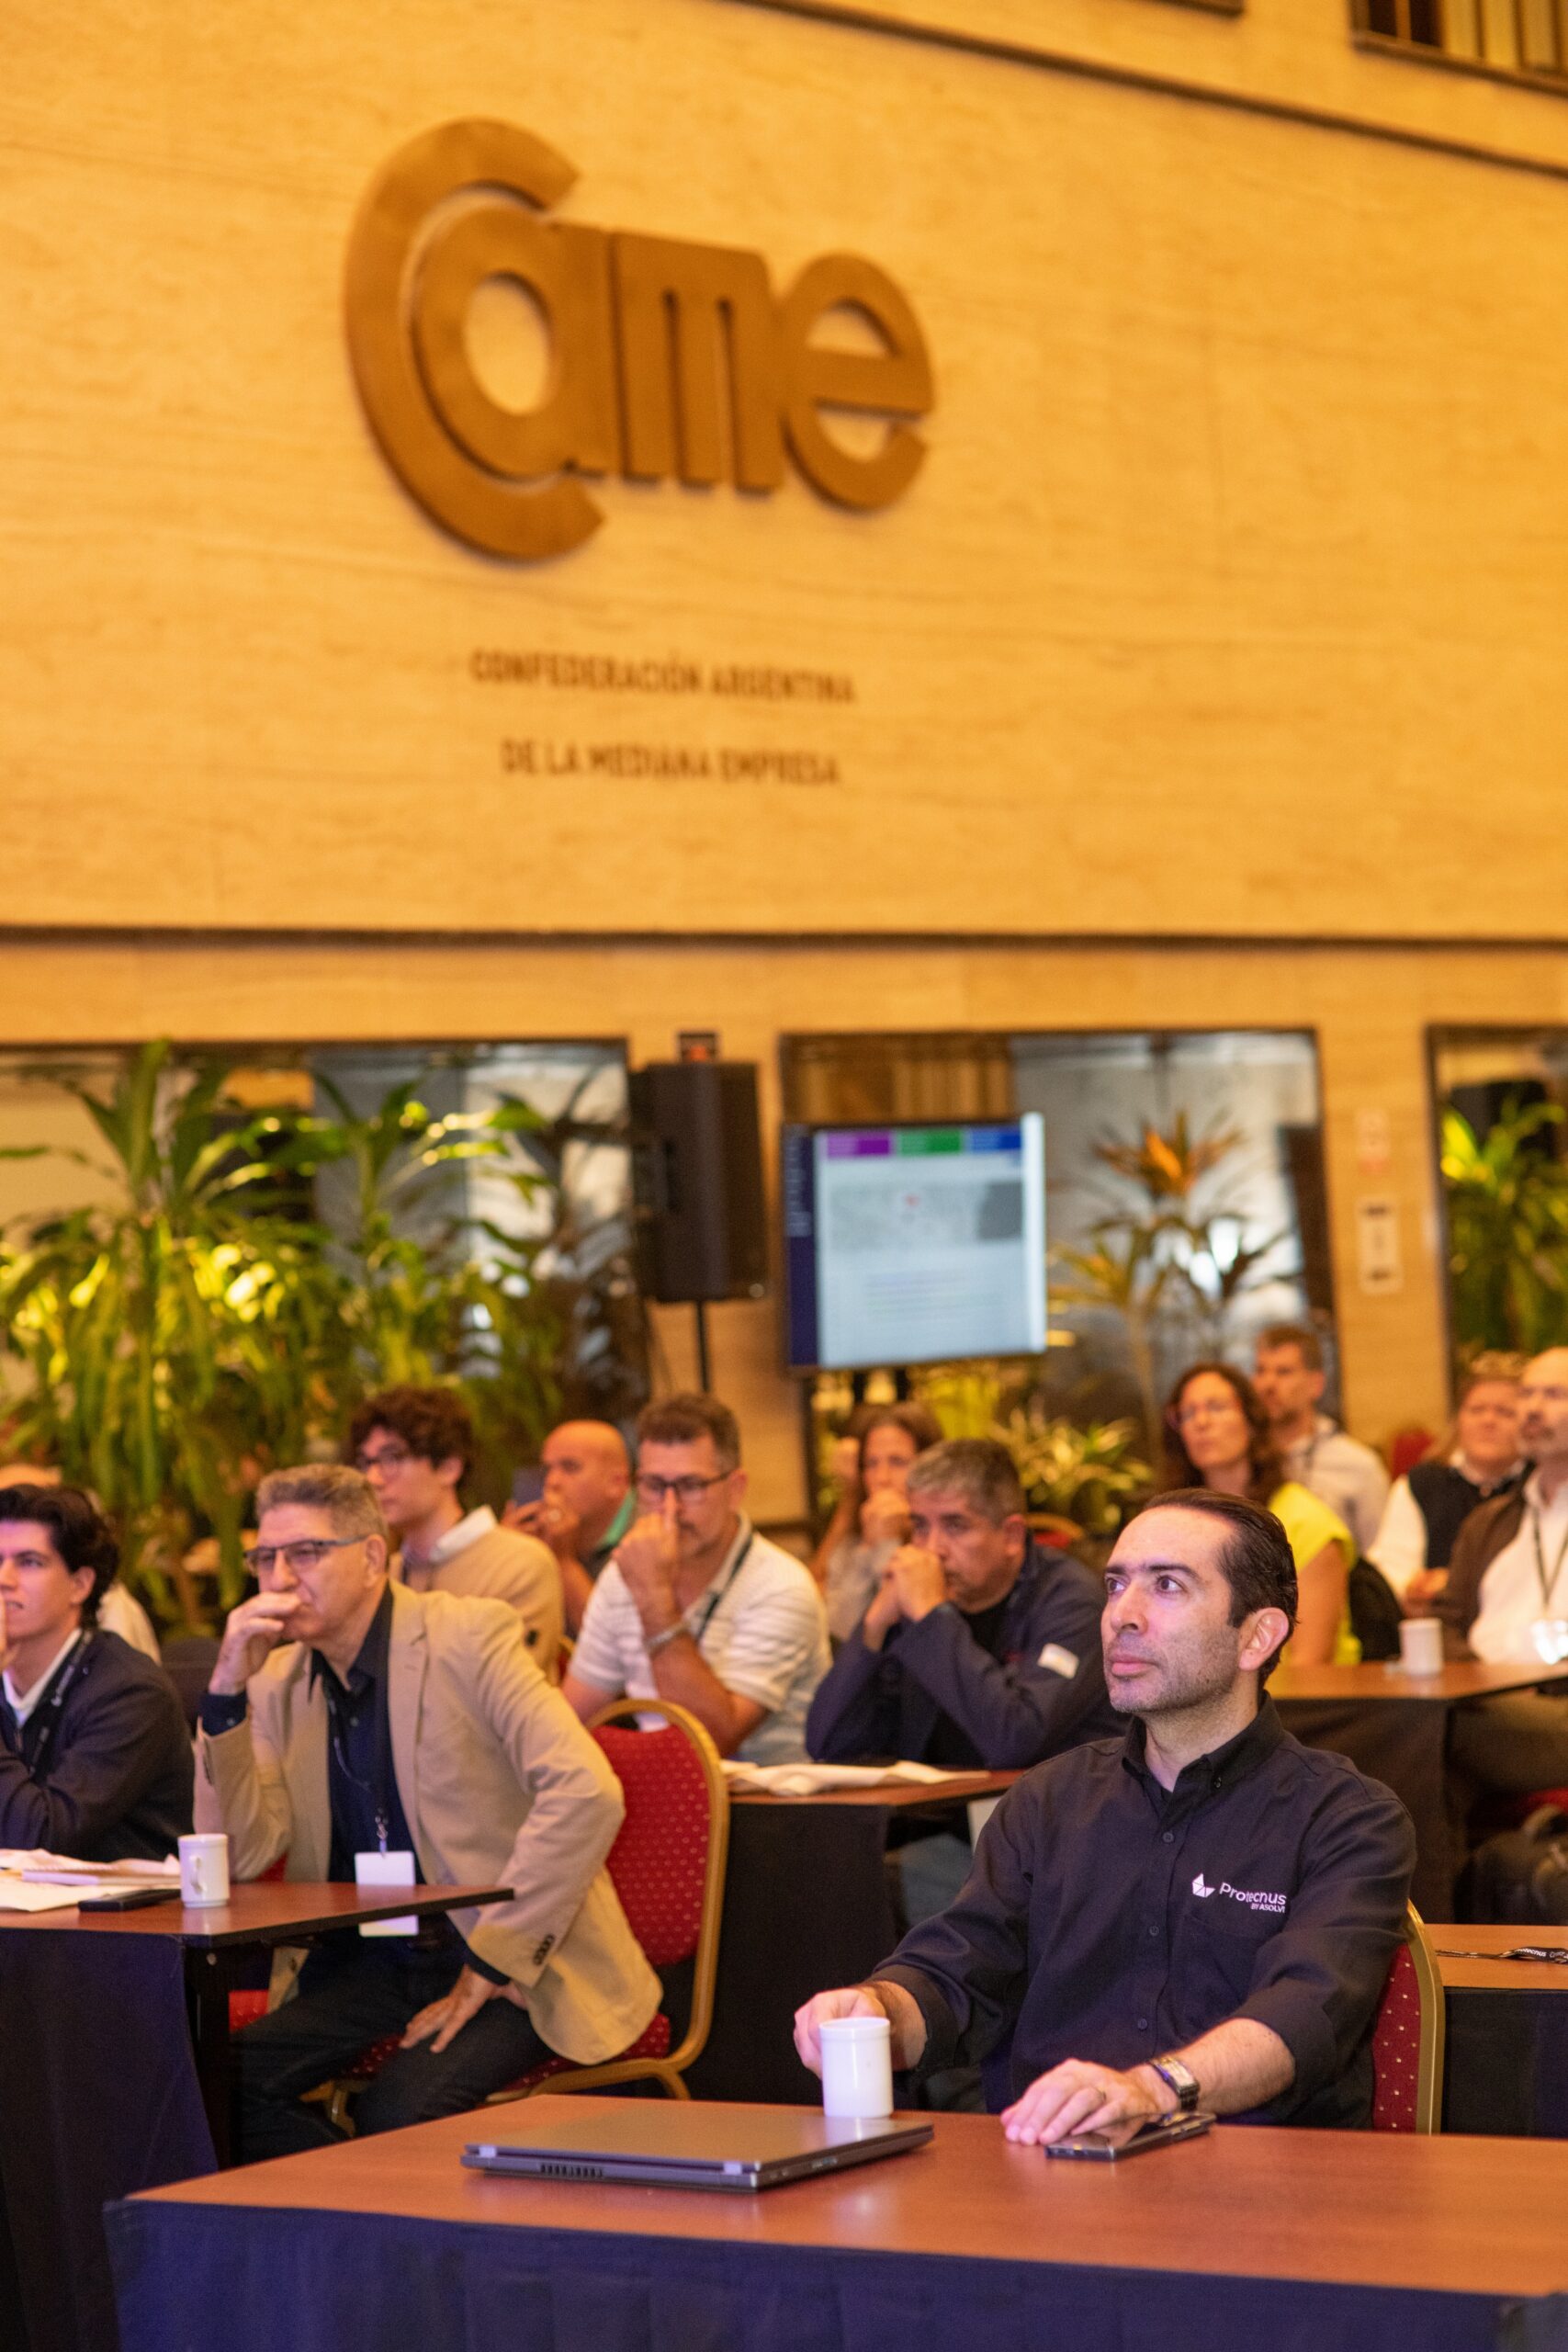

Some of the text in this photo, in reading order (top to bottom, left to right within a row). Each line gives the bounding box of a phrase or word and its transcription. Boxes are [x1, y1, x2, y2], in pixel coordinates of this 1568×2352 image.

[710, 663, 856, 703] ARGENTINA
[500, 738, 840, 786] DE LA MEDIANA EMPRESA
[1220, 1882, 1287, 1905] Protecnus
